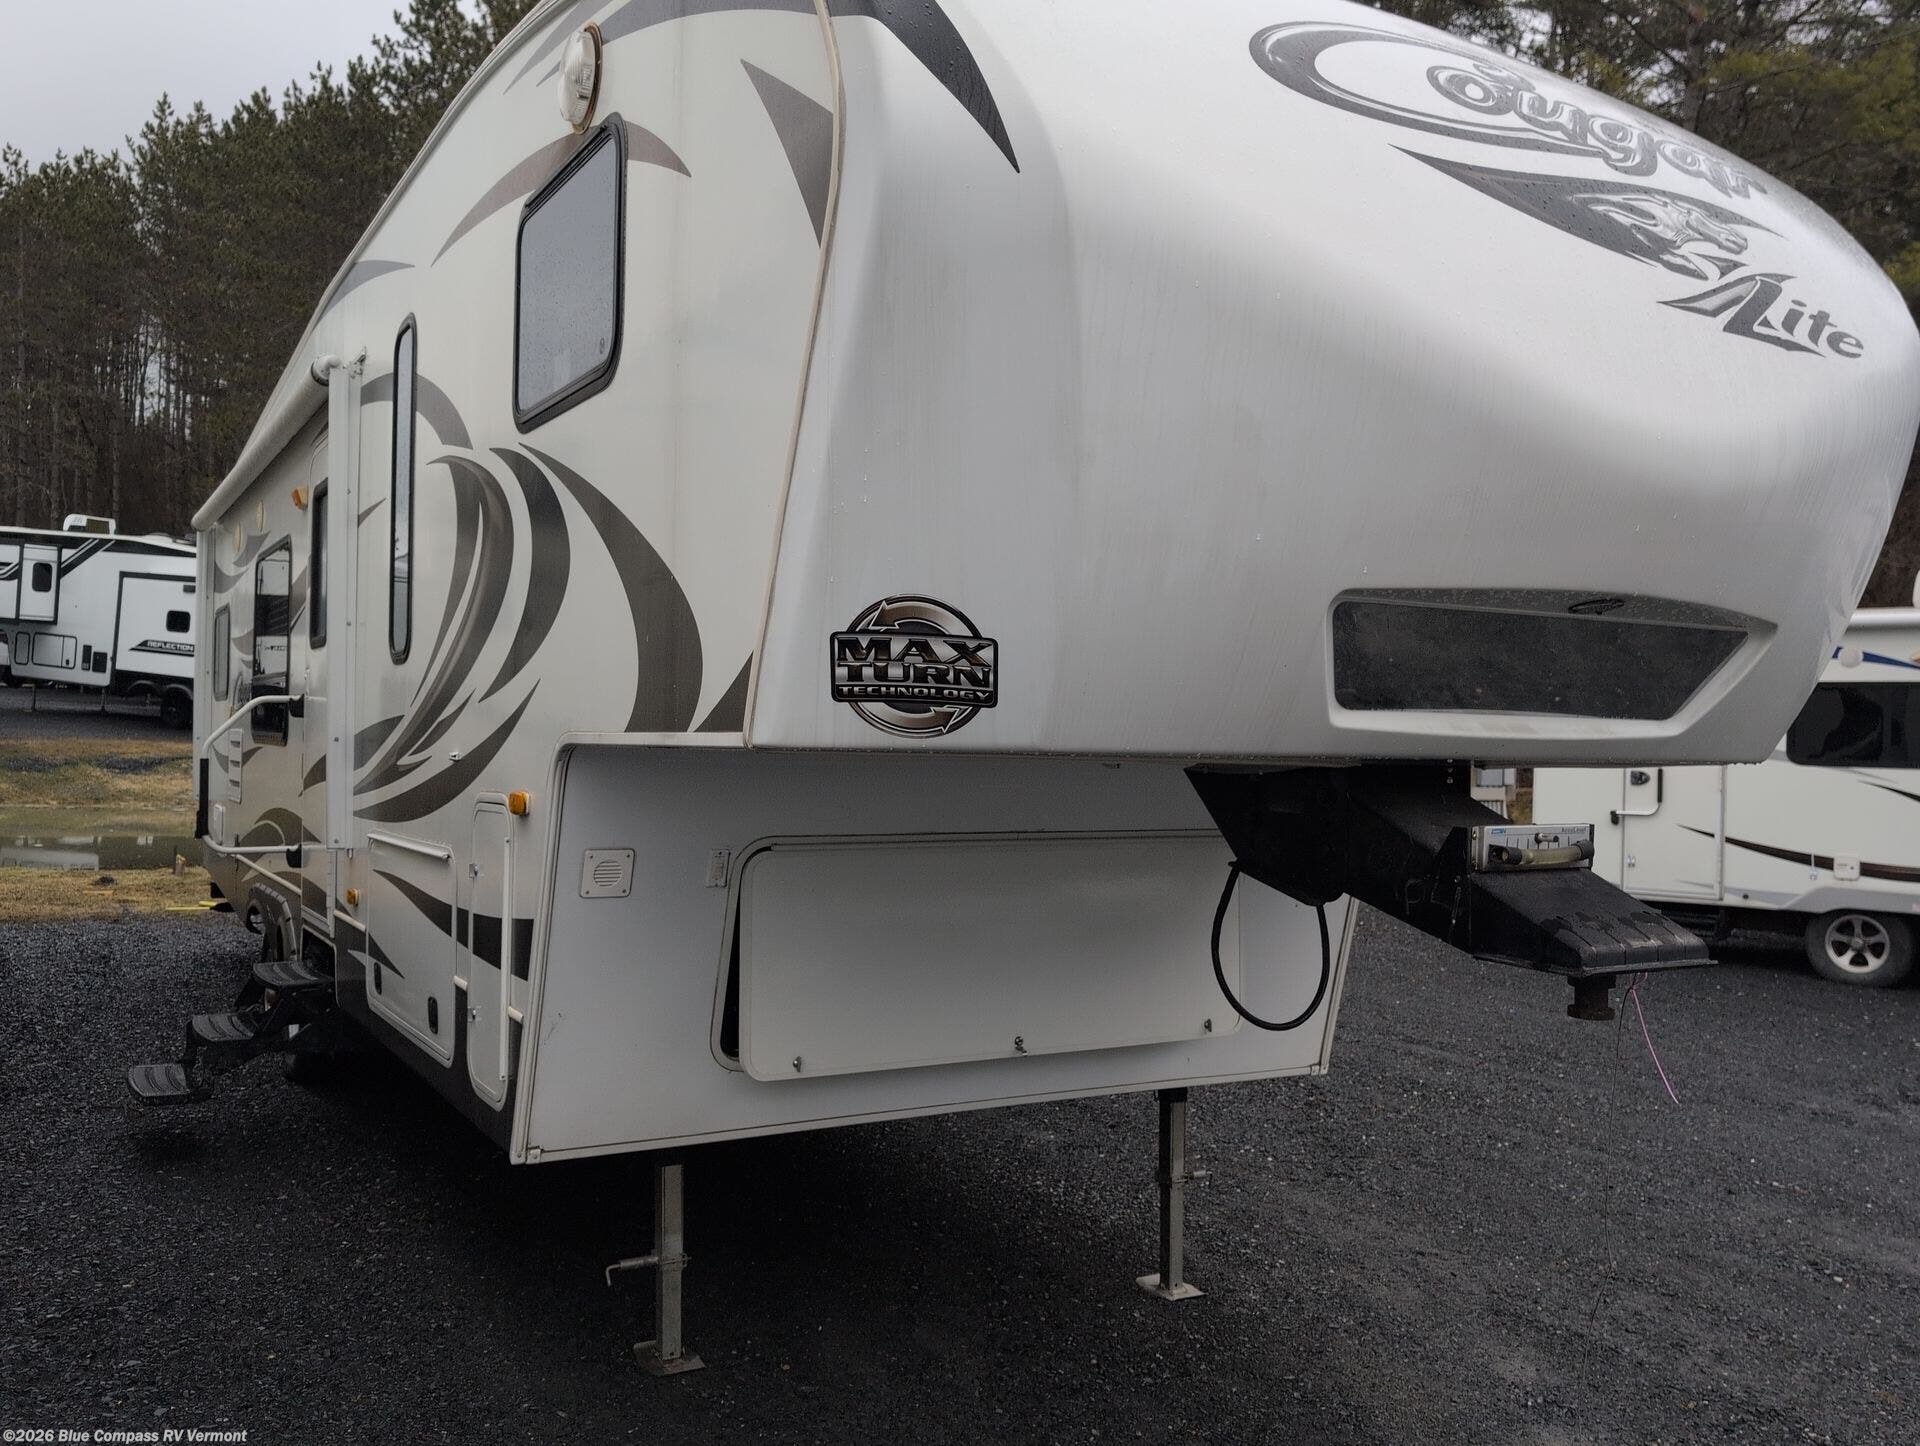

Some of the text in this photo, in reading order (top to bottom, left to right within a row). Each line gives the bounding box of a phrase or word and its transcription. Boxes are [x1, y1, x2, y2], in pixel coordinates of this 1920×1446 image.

[1656, 273, 1864, 359] Lite
[147, 640, 194, 652] REFLECTION
[836, 636, 993, 668] MAX
[837, 662, 992, 688] TURN
[838, 685, 991, 701] TECHNOLOGY
